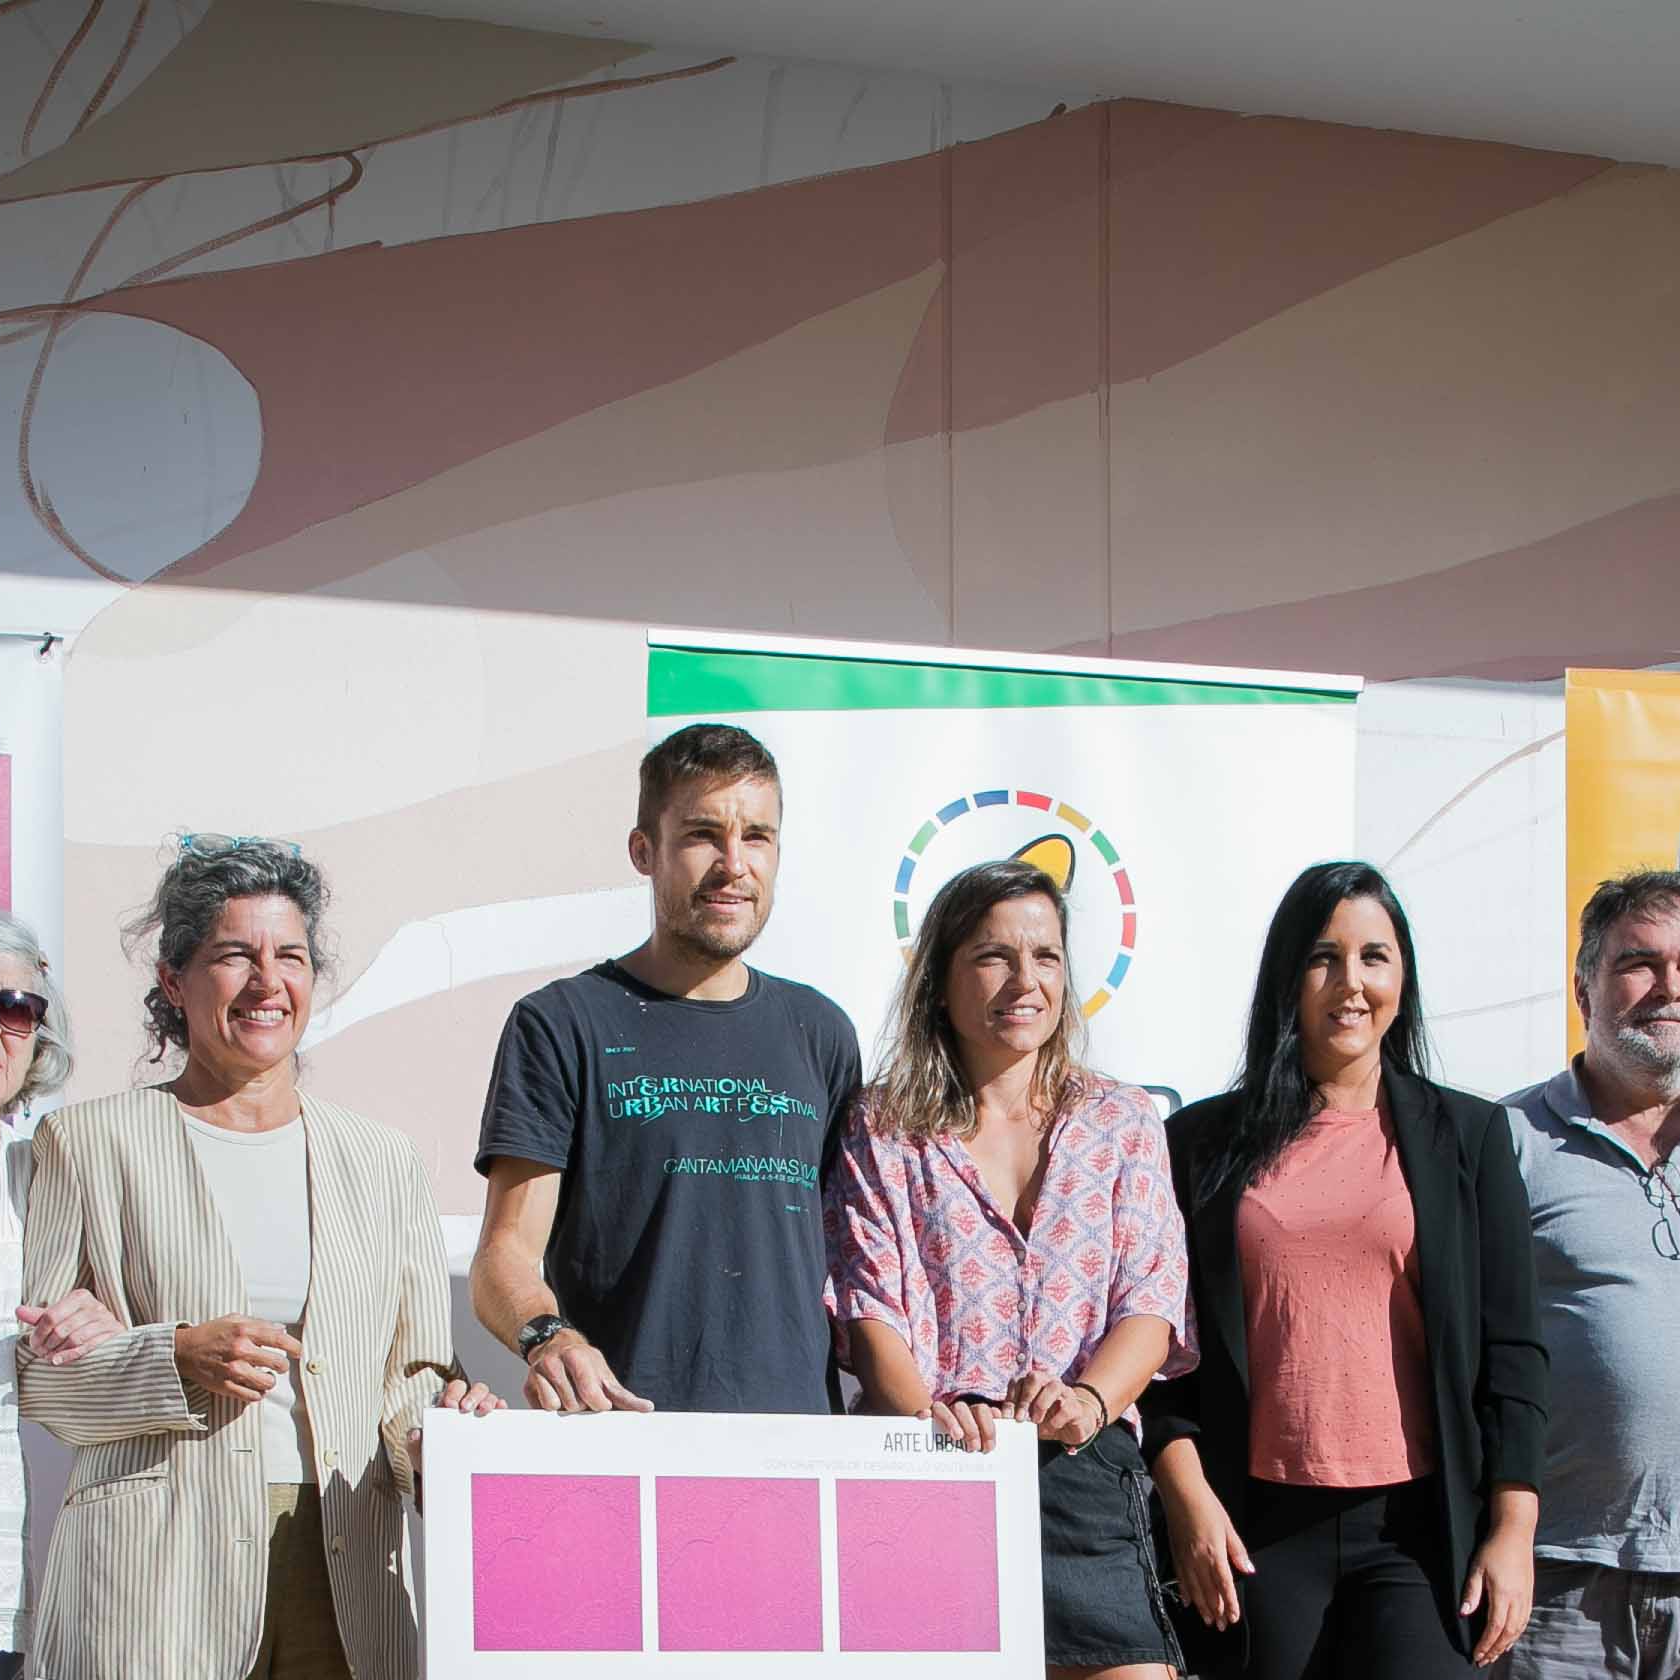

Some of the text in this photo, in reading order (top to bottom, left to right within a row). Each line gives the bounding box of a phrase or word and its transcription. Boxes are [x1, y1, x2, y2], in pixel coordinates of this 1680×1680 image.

[607, 1074, 772, 1099] INTERNATIONAL
[609, 1095, 688, 1126] URBAN
[663, 1154, 799, 1177] CANTAMAÑANAS
[883, 1431, 921, 1453] ARTE
